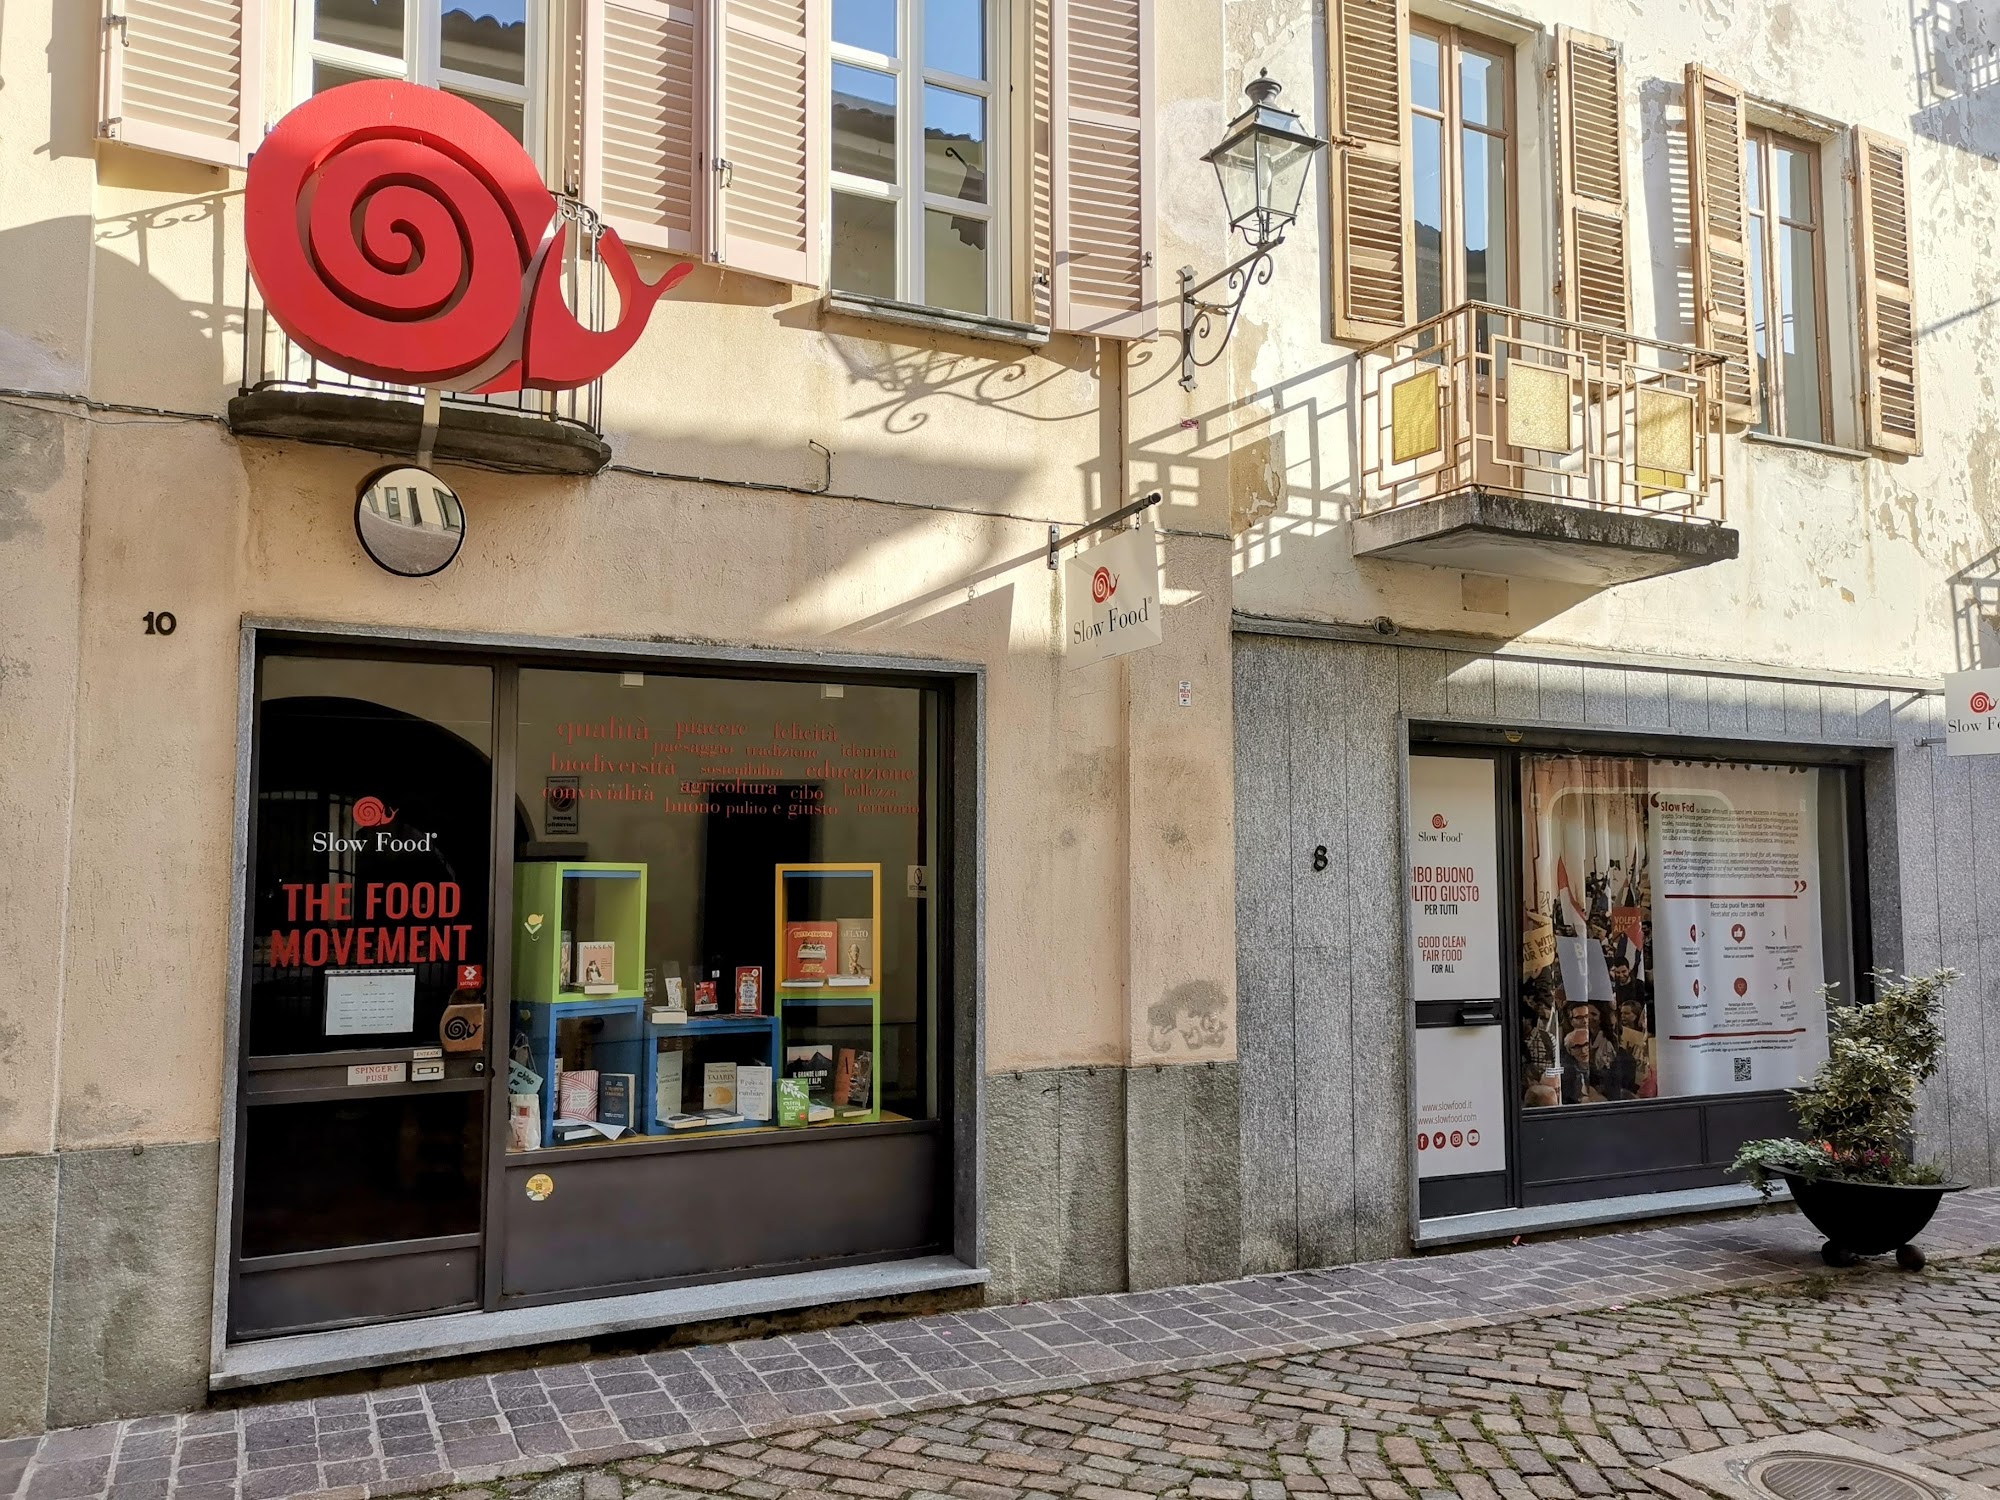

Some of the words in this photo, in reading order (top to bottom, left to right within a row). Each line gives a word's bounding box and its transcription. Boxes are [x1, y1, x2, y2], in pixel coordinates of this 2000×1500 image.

[143, 611, 177, 636] 10
[1073, 619, 1104, 645] Slow
[556, 716, 649, 745] qualità
[676, 717, 747, 740] piacere
[774, 722, 839, 743] felicità
[1948, 719, 1981, 733] Slow
[653, 742, 734, 757] paesaggio
[745, 744, 819, 759] tradizione
[841, 744, 898, 759] identità
[552, 752, 677, 776] biodiversità
[805, 760, 915, 781] educazione
[542, 783, 655, 801] convivialità
[680, 777, 777, 797] agricoltura
[790, 785, 824, 800] cibo
[843, 783, 897, 797] bellezza
[664, 797, 721, 814] buono
[726, 802, 768, 818] pulito
[772, 804, 781, 815] e
[788, 802, 839, 820] giusto
[857, 802, 919, 815] territorio
[1661, 801, 1681, 812] Slow
[313, 832, 368, 852] Slow
[1418, 831, 1438, 843] Slow
[1313, 845, 1328, 872] 8
[1411, 866, 1432, 883] IBO
[1436, 866, 1474, 883] BUONO
[1411, 886, 1437, 902] LITO
[1440, 886, 1479, 902] GIUSTO
[282, 883, 353, 922] THE
[366, 882, 461, 920] FOOD
[1424, 904, 1438, 915] PER
[1440, 904, 1458, 915] TUTTI
[270, 925, 472, 968] MOVEMENT
[1418, 936, 1440, 948] GOOD
[1442, 935, 1467, 948] CLEAN
[1422, 950, 1440, 962] FAIR
[1442, 950, 1463, 961] FOOD
[1431, 964, 1443, 974] FOR
[1444, 964, 1455, 974] ALL
[355, 1065, 400, 1075] SPINGERE
[798, 1070, 814, 1078] GRANDE
[814, 1070, 828, 1078] LIBRO
[366, 1074, 388, 1083] PUSH
[1422, 1100, 1473, 1112] www.slowfood.it
[1418, 1113, 1478, 1126] www.slowfood.com
